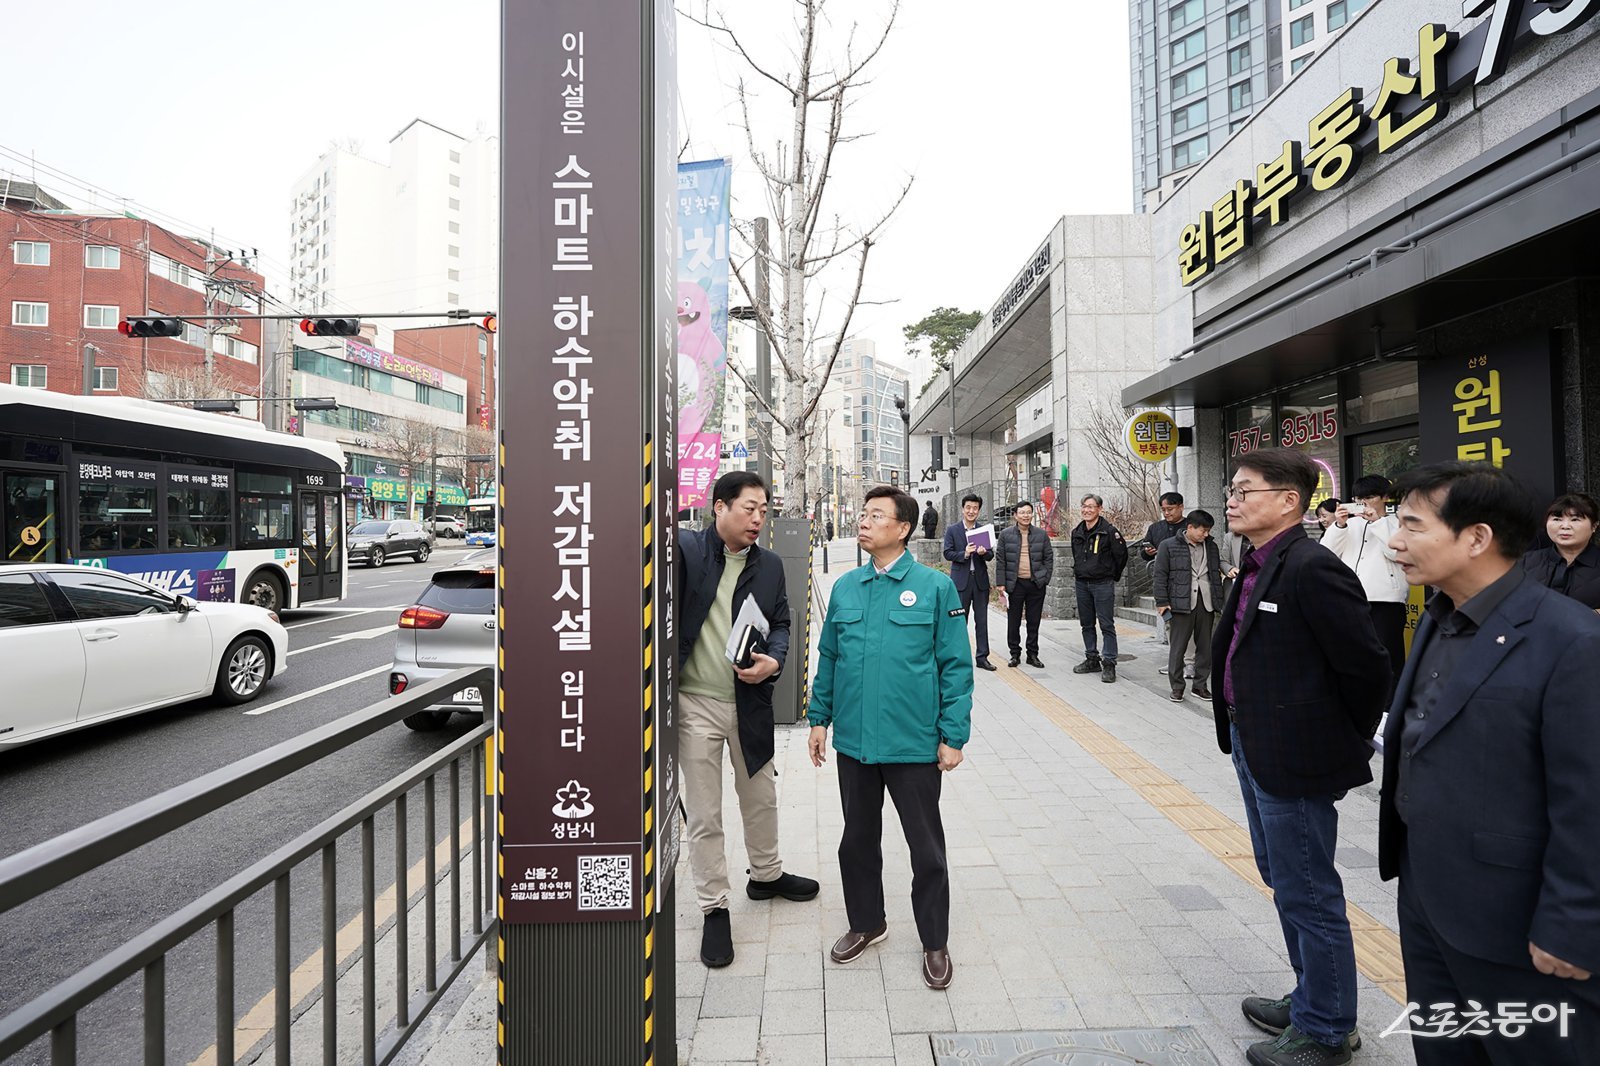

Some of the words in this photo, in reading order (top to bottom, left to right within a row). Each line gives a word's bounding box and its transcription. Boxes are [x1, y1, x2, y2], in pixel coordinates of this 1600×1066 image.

[560, 31, 586, 134] 이시설은
[1178, 23, 1450, 287] 원탑부동산
[552, 154, 594, 271] 스마트
[695, 195, 720, 214] 친구
[677, 222, 727, 274] 치
[1468, 354, 1488, 369] 산성
[552, 295, 594, 461] 하수악취
[1134, 421, 1173, 442] 원탑
[1281, 408, 1338, 447] 3515
[1139, 444, 1169, 455] 부동산
[115, 470, 134, 479] 야탑역
[137, 472, 156, 480] 모란역
[171, 474, 189, 483] 태평역
[192, 475, 209, 484] 위례동
[211, 474, 229, 483] 복정역
[306, 475, 324, 486] 1695
[678, 467, 712, 490] 트홀
[371, 482, 394, 499] 한양
[396, 484, 425, 501] 부산
[552, 481, 595, 651] 저감시설
[665, 488, 674, 639] 저감시설
[560, 670, 586, 752] 입니다
[551, 822, 596, 840] 성남시
[524, 867, 559, 880] 신흥-2
[511, 882, 536, 891] 스마트
[539, 881, 572, 891] 하수악취
[511, 892, 540, 901] 저감시설
[541, 892, 556, 900] 정보
[557, 891, 572, 900] 보기
